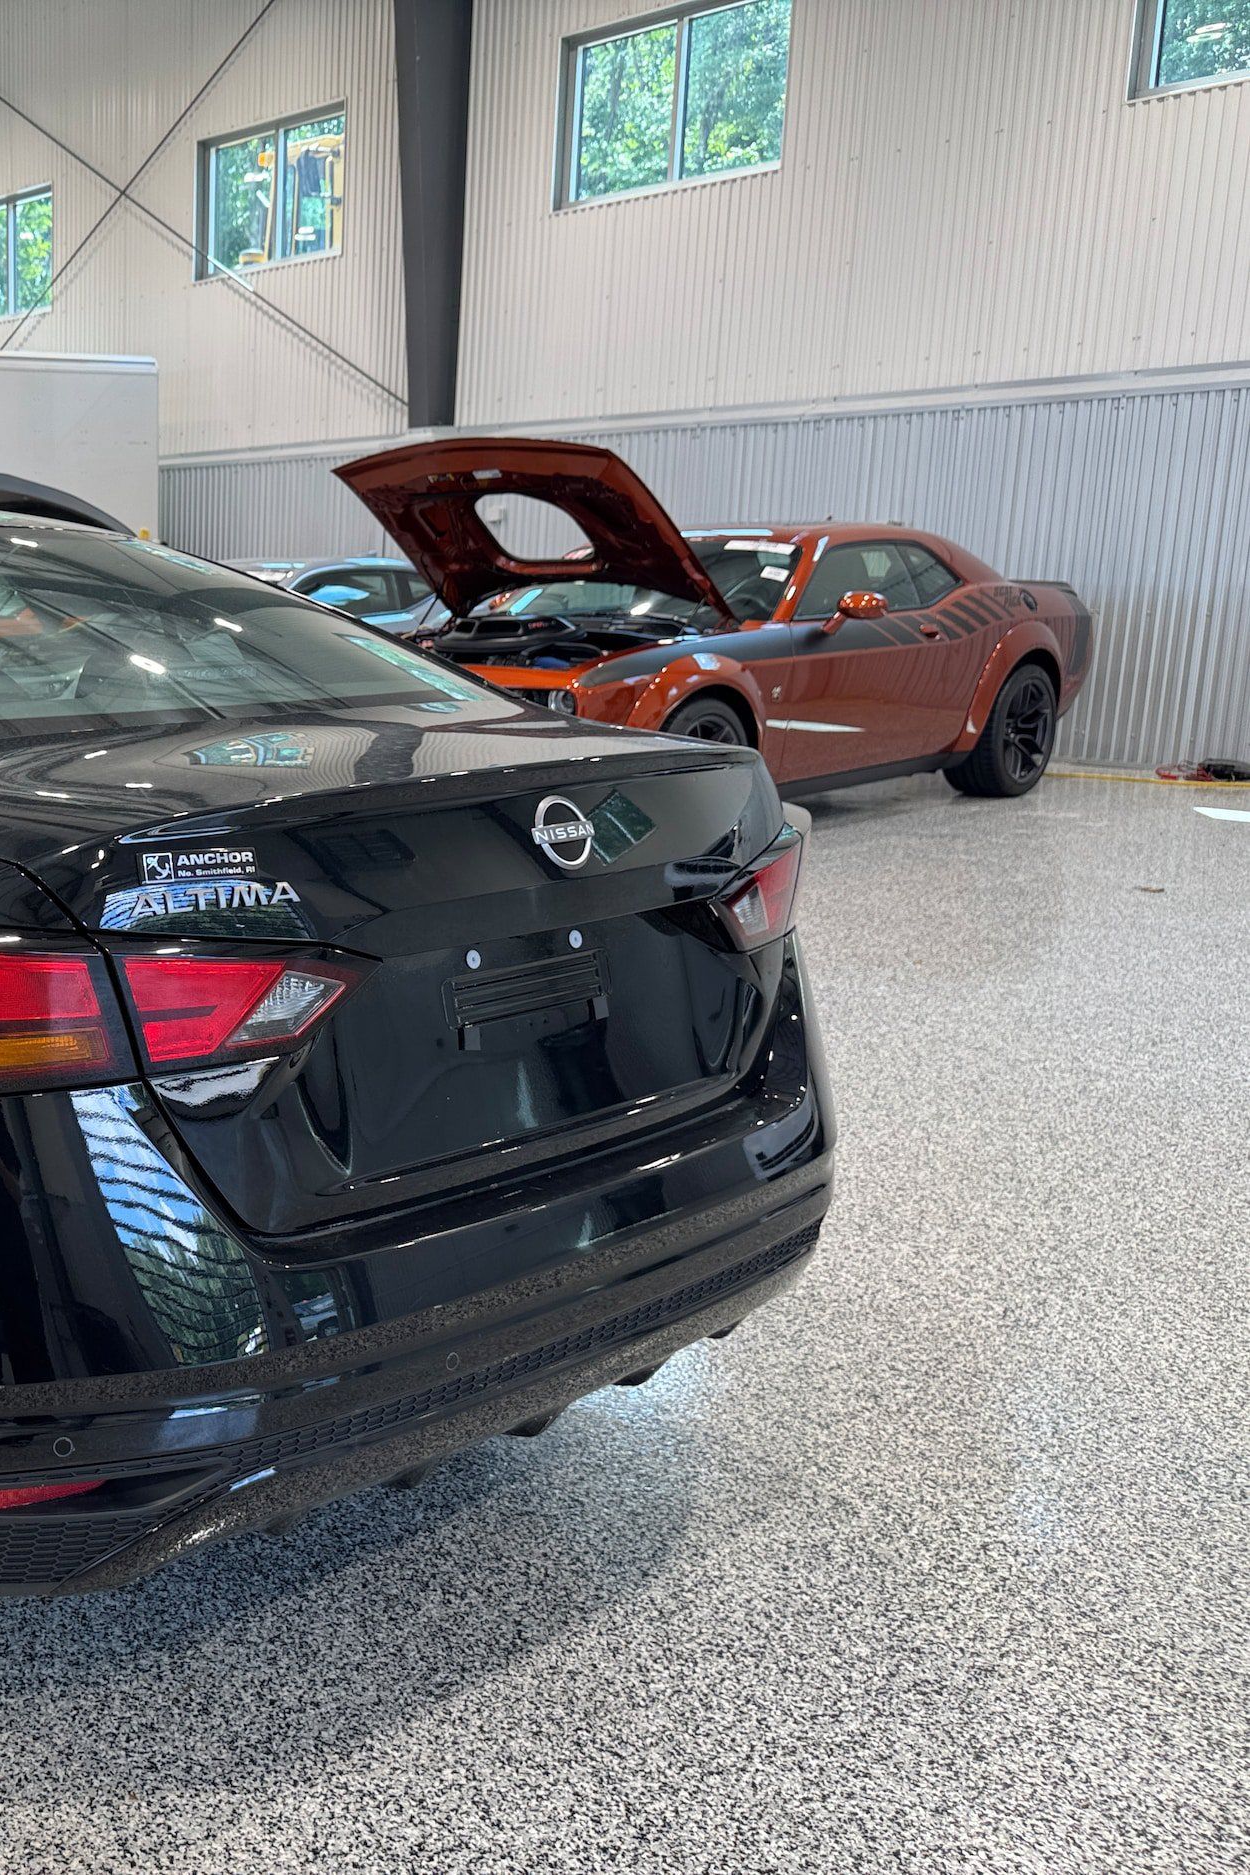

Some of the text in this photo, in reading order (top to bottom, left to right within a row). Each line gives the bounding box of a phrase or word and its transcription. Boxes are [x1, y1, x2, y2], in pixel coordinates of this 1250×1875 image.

[534, 824, 594, 842] NISSAN
[176, 851, 254, 866] ANCHOR
[178, 869, 194, 877] No.
[196, 866, 244, 876] Smithfield,
[129, 881, 301, 918] ALTIMA
